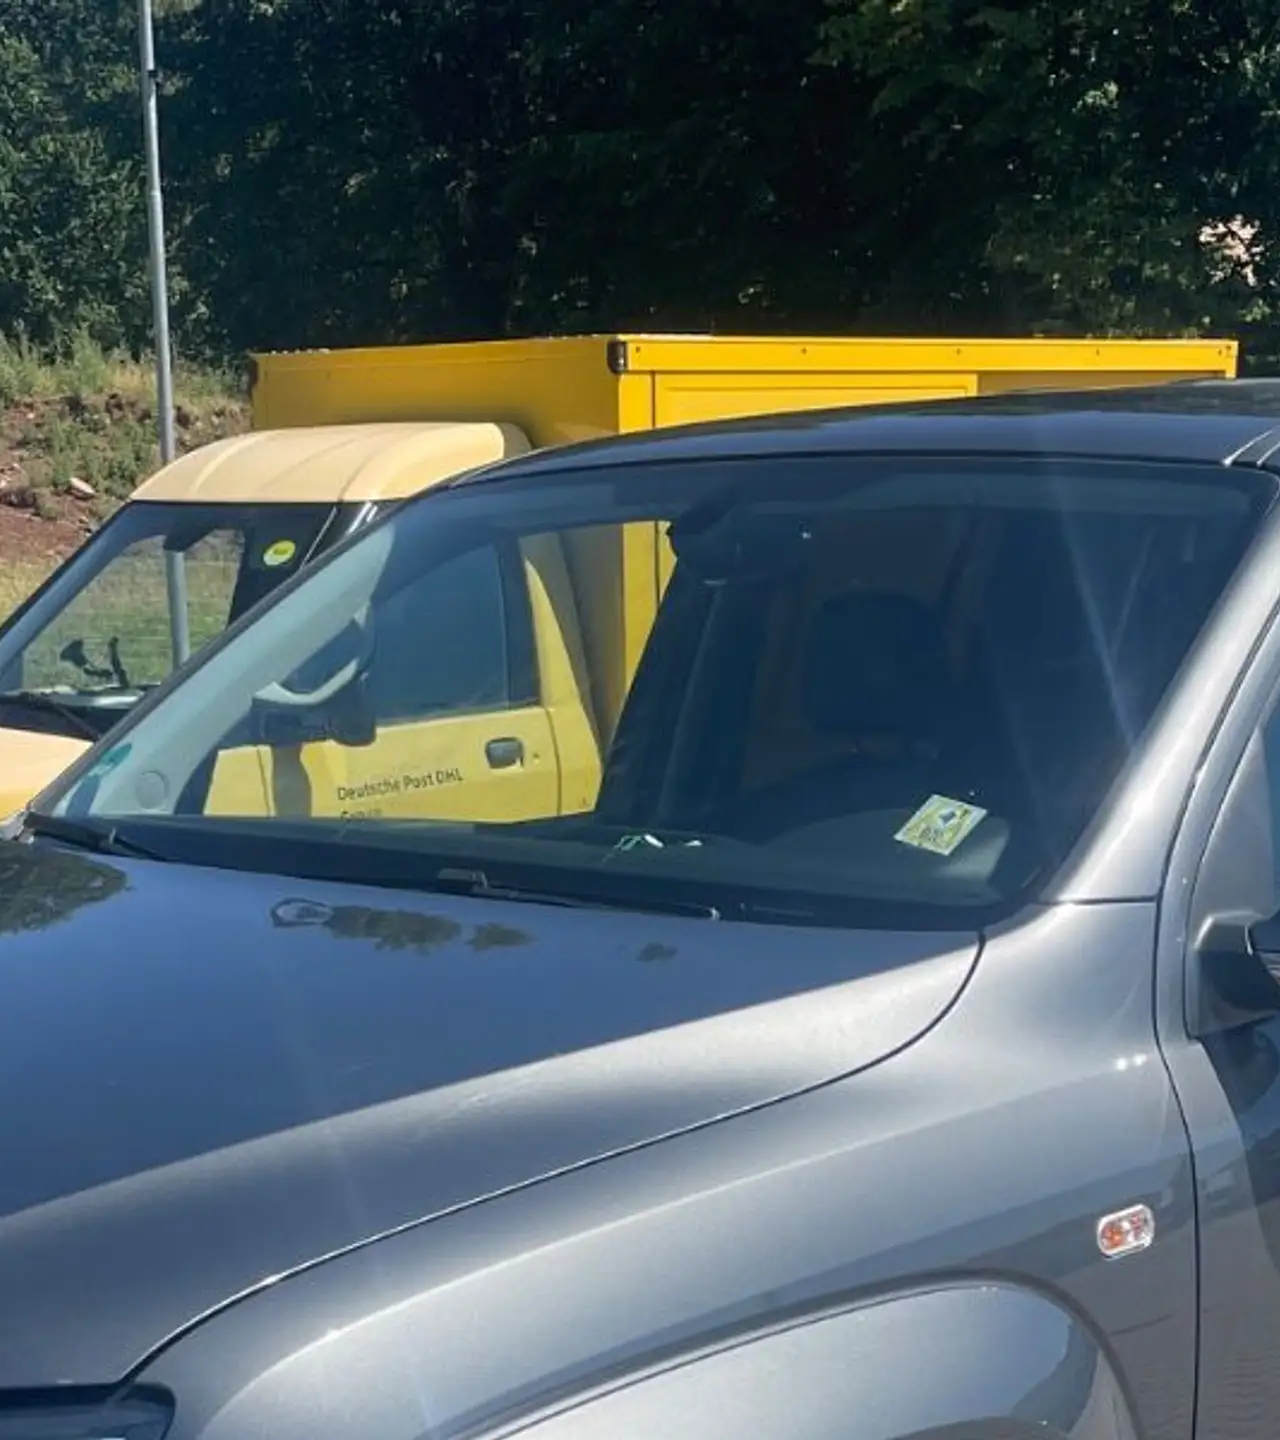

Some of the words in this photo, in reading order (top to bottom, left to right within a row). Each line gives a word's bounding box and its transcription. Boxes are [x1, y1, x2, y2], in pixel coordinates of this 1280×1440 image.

[337, 779, 401, 801] Deutsche
[402, 774, 435, 791] Post
[435, 768, 463, 785] DHL
